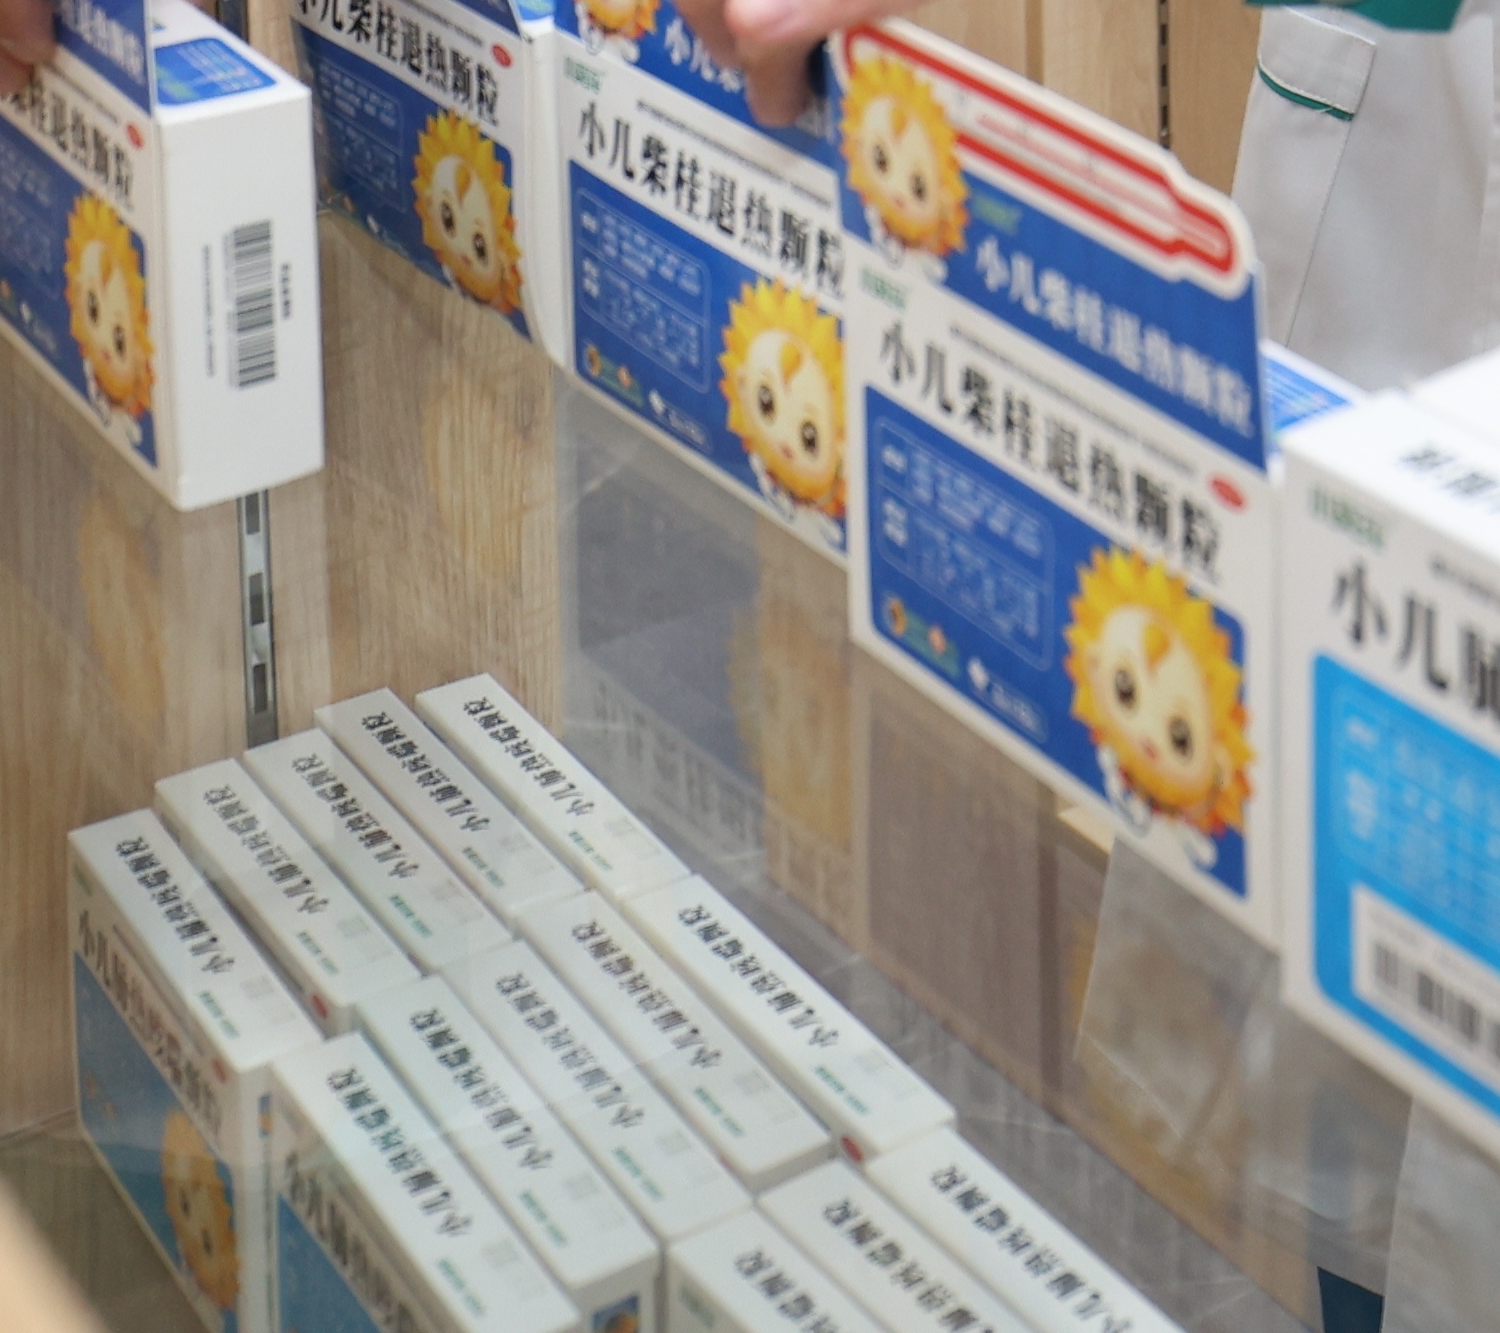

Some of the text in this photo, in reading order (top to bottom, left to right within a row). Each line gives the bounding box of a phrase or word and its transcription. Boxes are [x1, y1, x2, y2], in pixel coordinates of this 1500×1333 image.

[579, 101, 846, 300] 小儿柴桂退热颗粒
[880, 323, 1222, 587] 小儿柴桂退热颗粒
